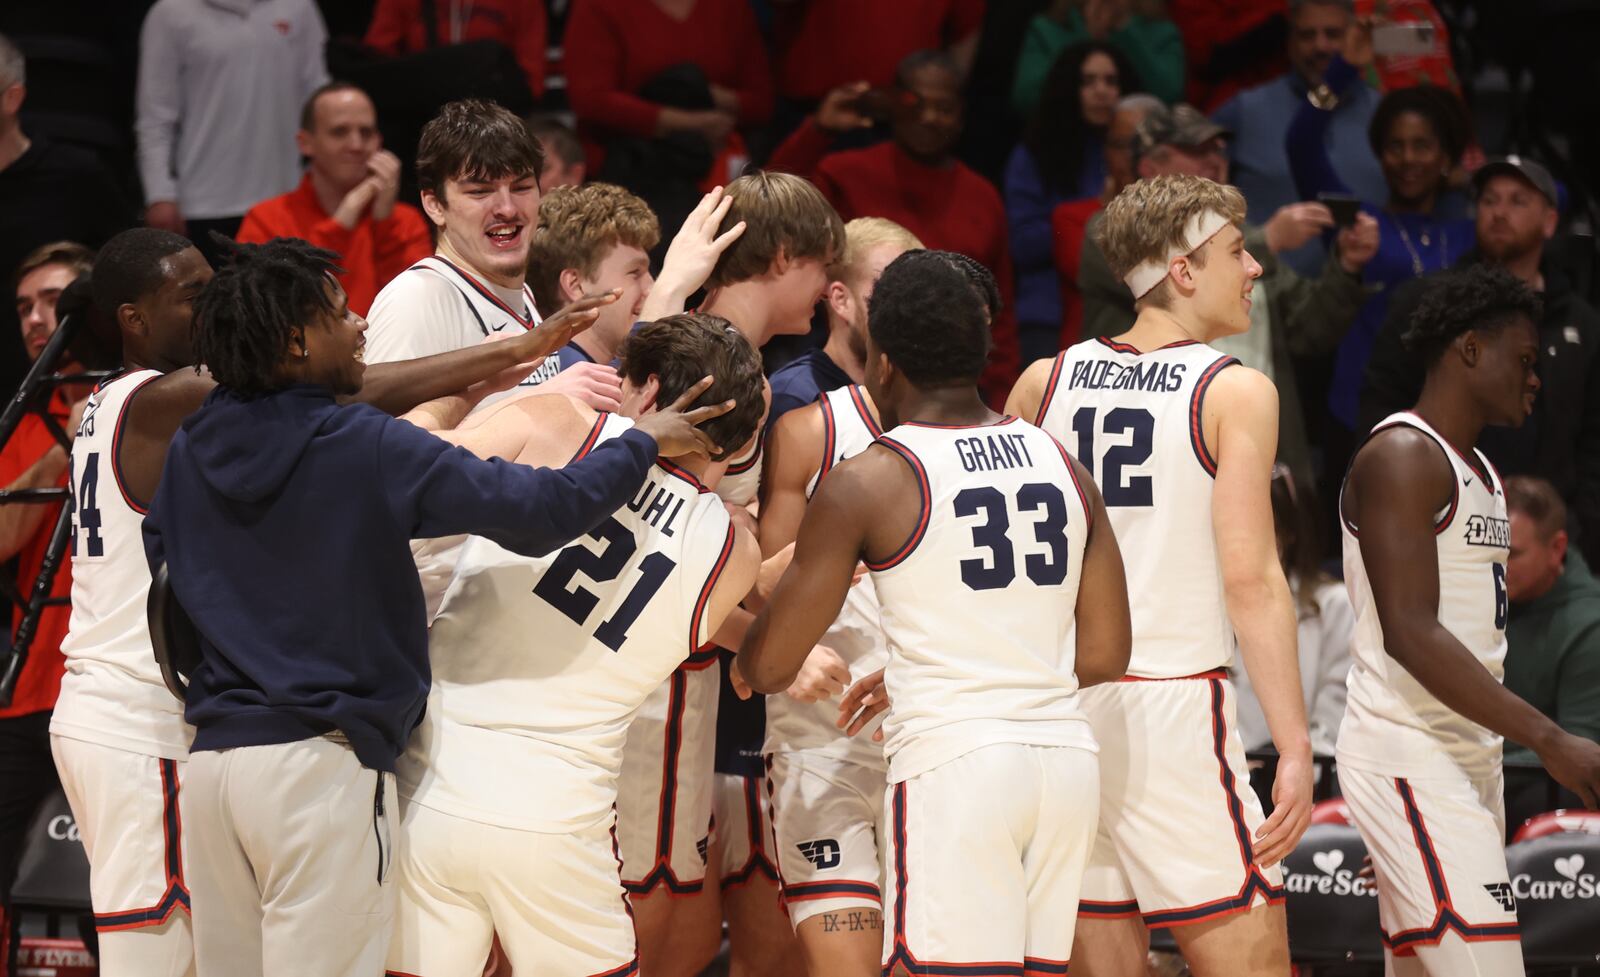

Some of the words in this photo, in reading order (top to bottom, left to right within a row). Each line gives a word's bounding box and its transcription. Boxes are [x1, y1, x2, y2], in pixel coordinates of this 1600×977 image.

[1068, 360, 1187, 392] PADEGIMAS
[954, 434, 1033, 473] GRANT
[1072, 406, 1156, 507] 12
[953, 482, 1068, 591] 33
[532, 515, 677, 654] 21
[1492, 561, 1508, 630] 6
[1511, 873, 1600, 899] CareS
